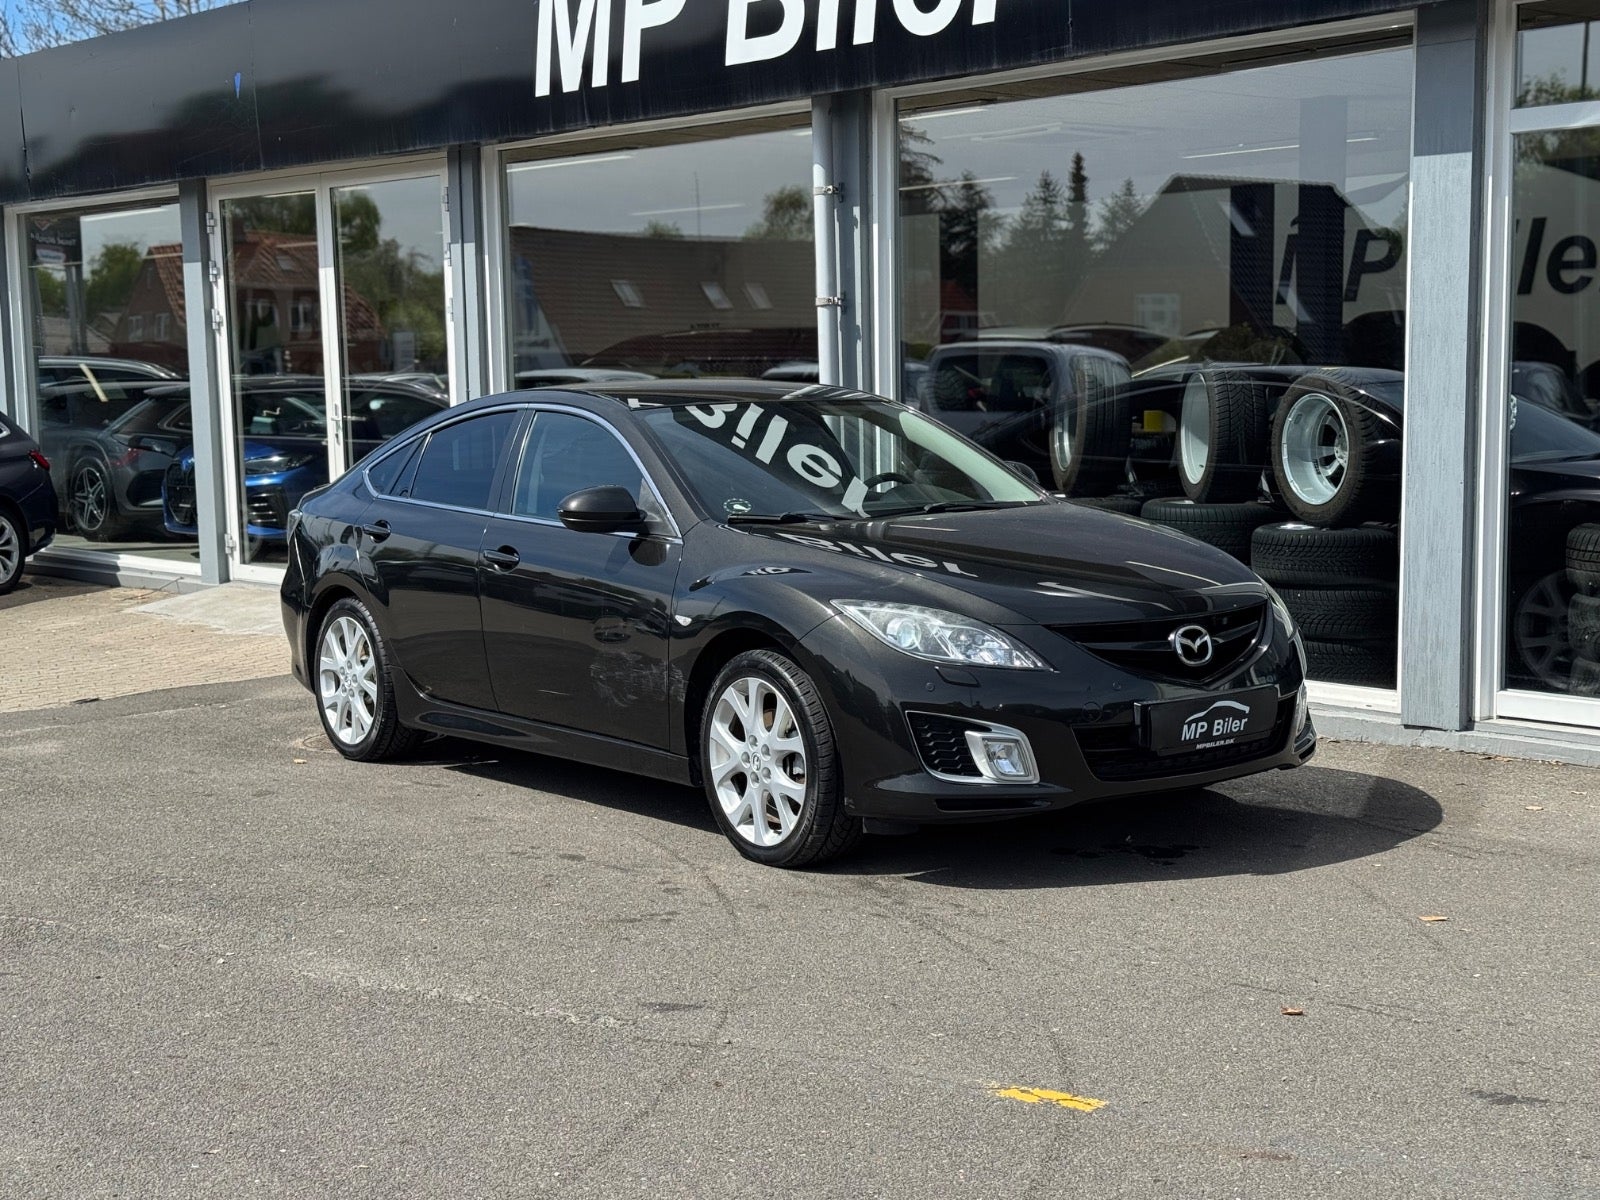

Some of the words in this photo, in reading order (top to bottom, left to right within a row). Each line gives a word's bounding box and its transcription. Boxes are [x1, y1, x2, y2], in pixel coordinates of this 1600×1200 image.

[535, 0, 688, 98] MP
[1181, 722, 1208, 741] MP
[1212, 717, 1248, 736] Biler
